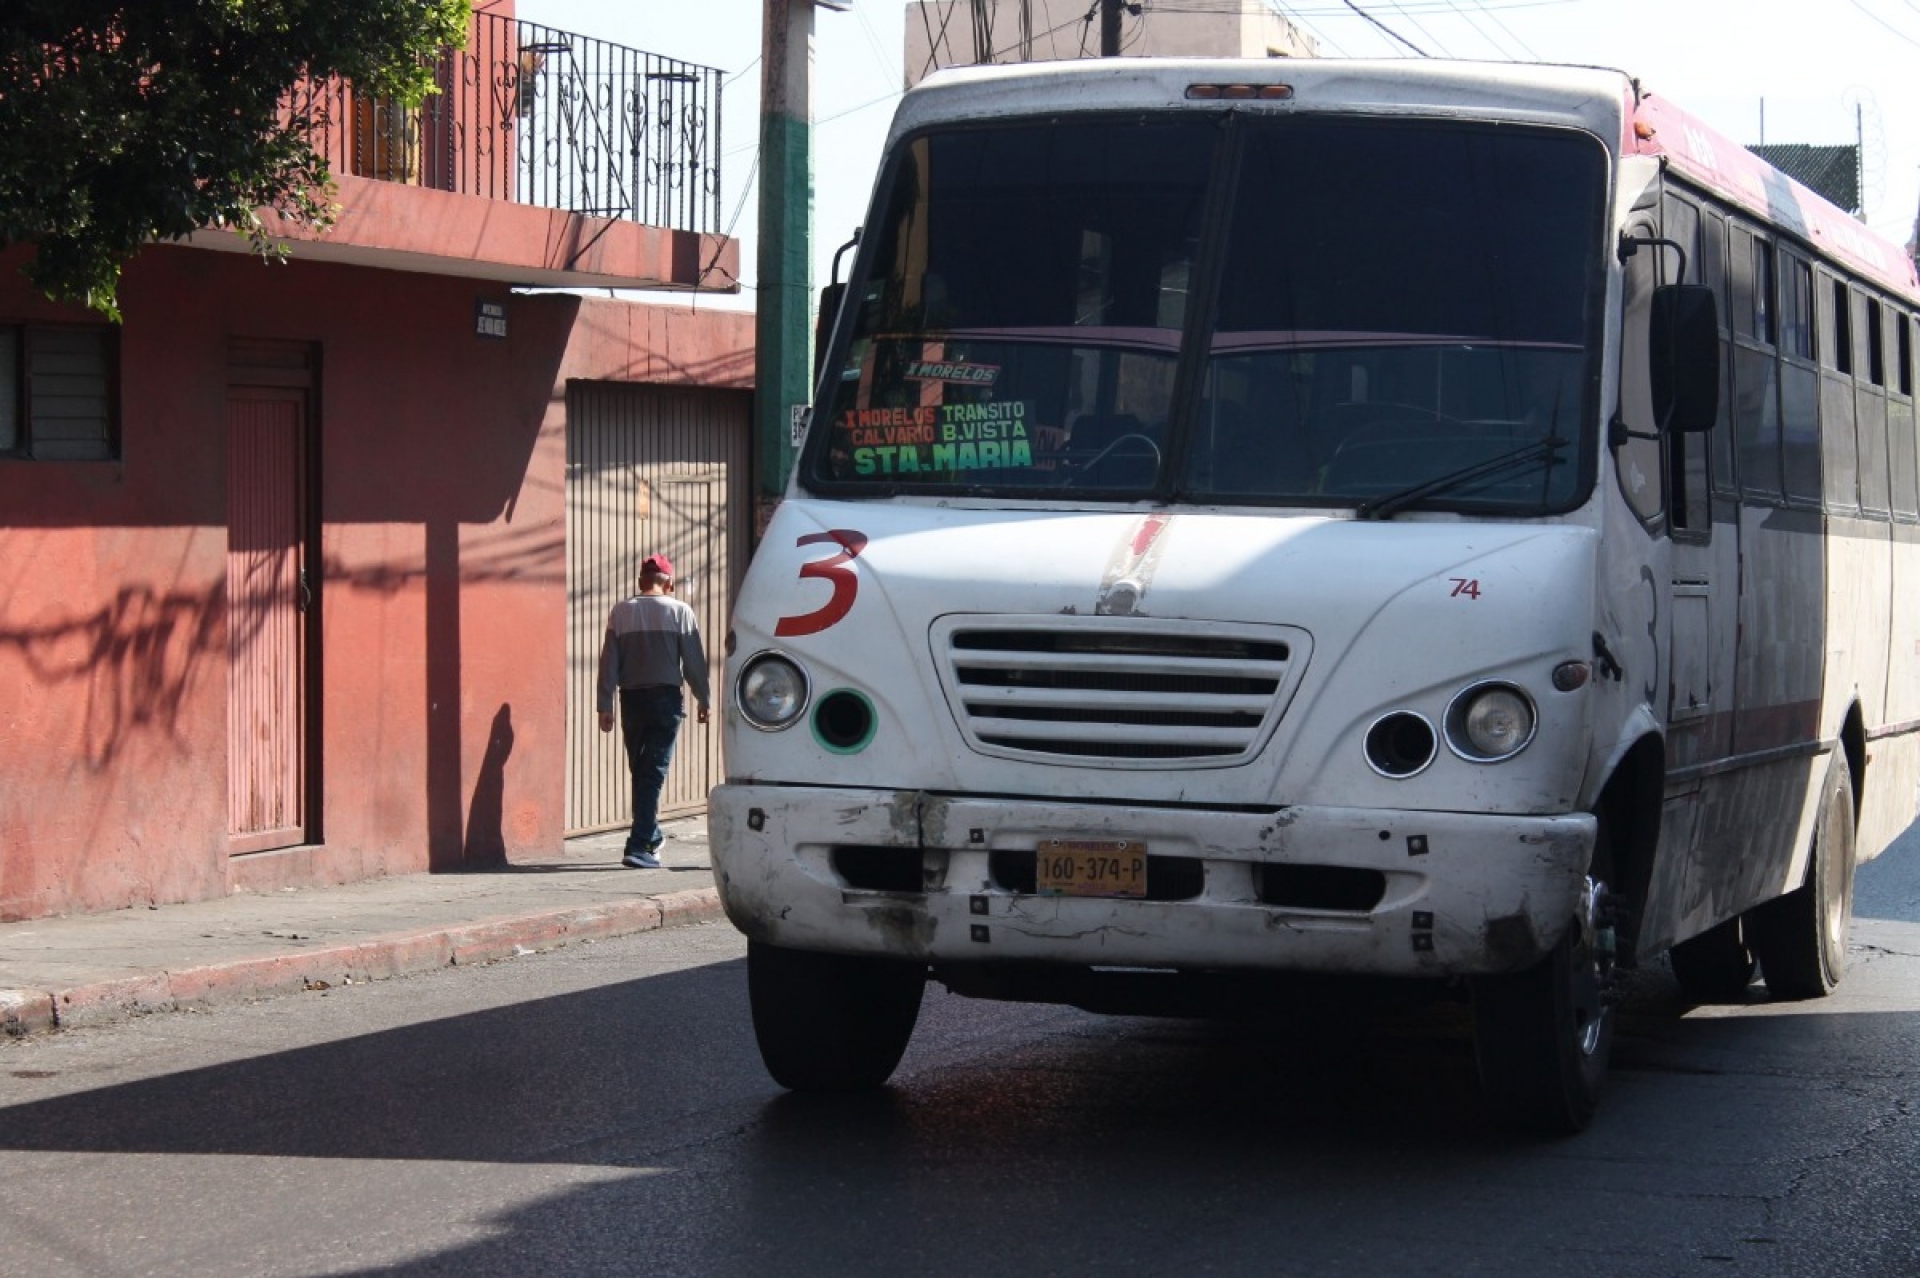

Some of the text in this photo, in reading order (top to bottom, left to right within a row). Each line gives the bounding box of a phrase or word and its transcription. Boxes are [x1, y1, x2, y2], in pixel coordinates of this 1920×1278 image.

[943, 402, 1025, 422] TRANSITO
[852, 421, 1027, 446] CALVARIO B.VISTA
[774, 529, 869, 637] 3
[1449, 578, 1481, 600] 74
[1641, 565, 1658, 706] 3
[1043, 856, 1143, 882] 160-374-P
